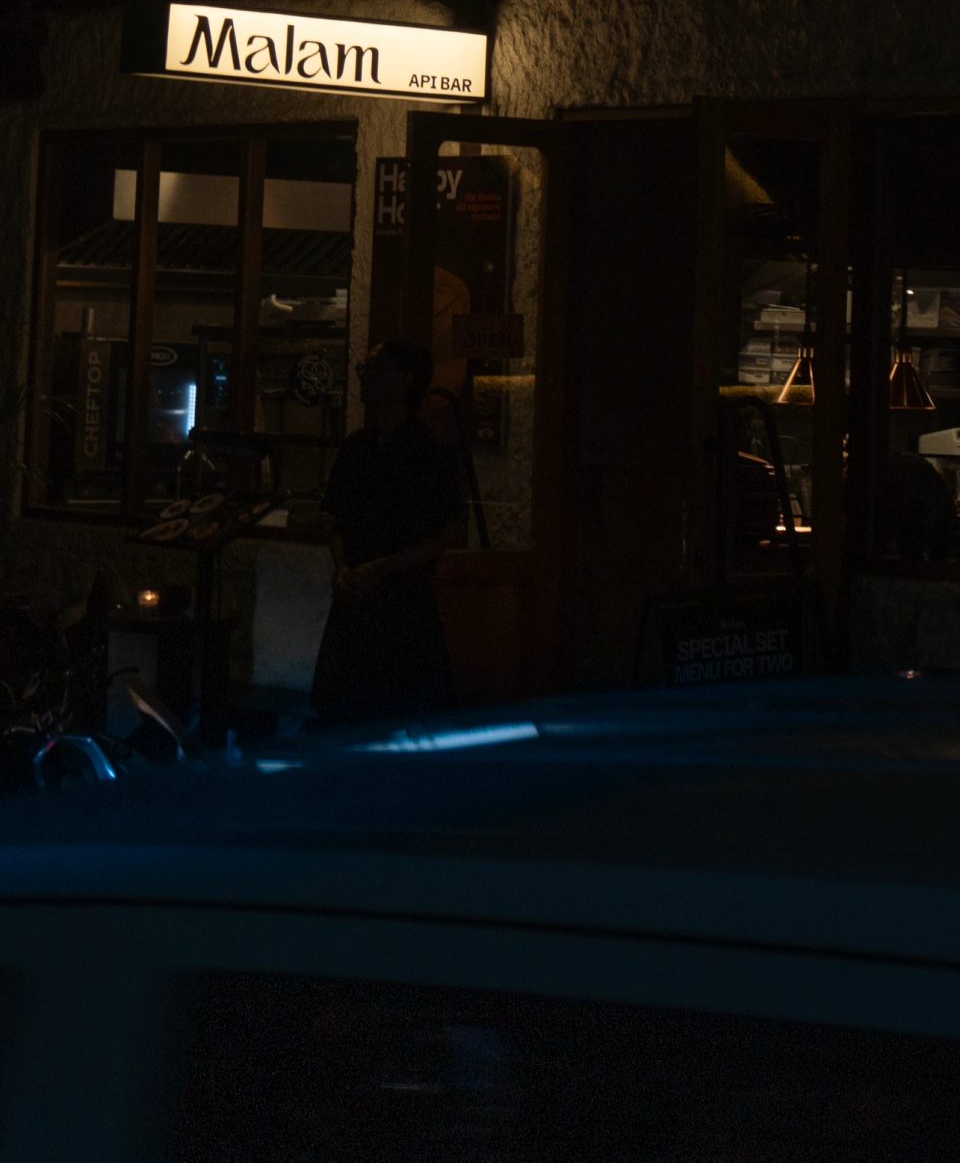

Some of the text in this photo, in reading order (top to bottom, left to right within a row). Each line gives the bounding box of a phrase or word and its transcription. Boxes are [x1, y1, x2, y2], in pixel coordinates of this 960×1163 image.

[179, 13, 382, 85] Malam
[408, 73, 473, 93] API BAR
[83, 351, 104, 457] CHEFTOP
[676, 628, 789, 663] SPECIAL SET
[674, 652, 795, 684] MENU FOR TWO
